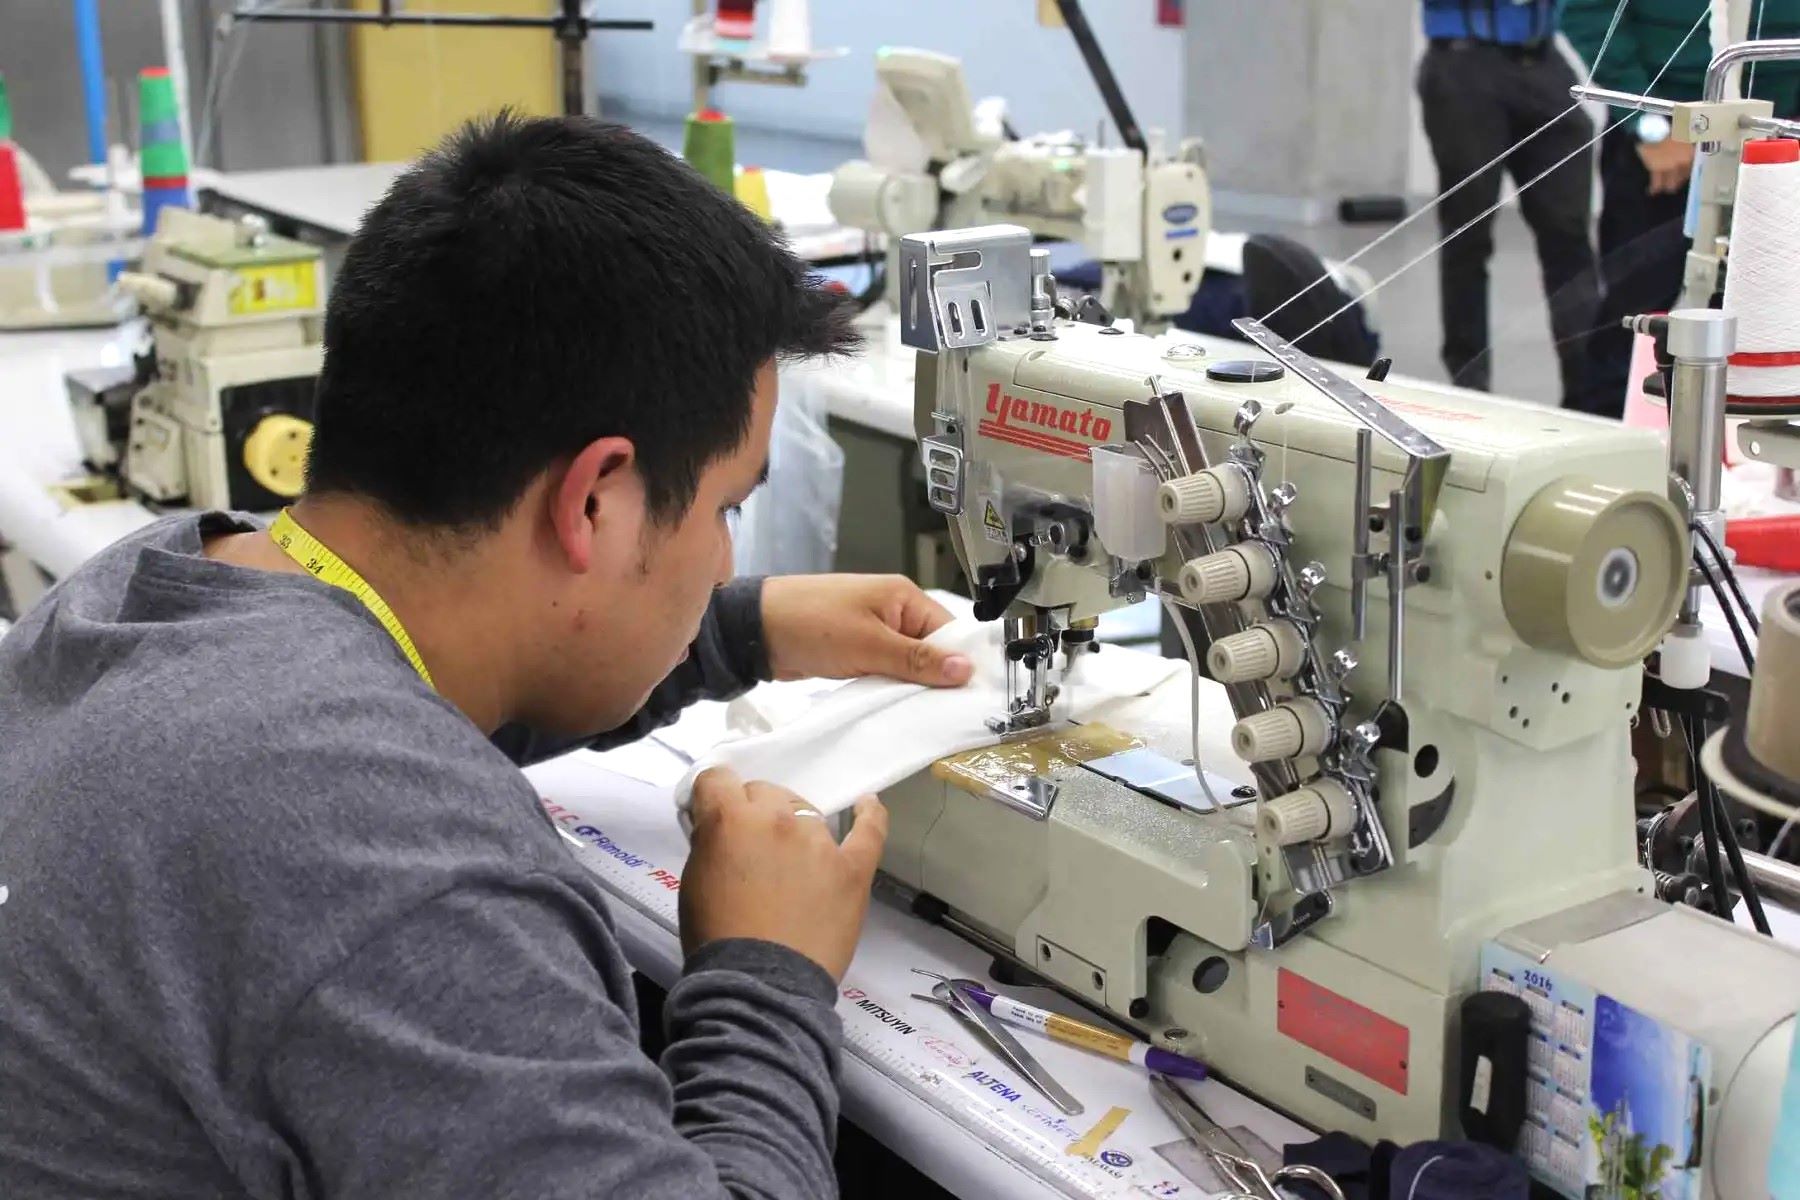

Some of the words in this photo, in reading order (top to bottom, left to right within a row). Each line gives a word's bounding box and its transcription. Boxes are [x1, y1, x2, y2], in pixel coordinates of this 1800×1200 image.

[985, 382, 1112, 442] Yamato
[306, 558, 324, 574] 34
[1523, 969, 1553, 992] 2016
[855, 999, 917, 1035] MITSUYIN
[962, 1070, 1022, 1102] ALTENA
